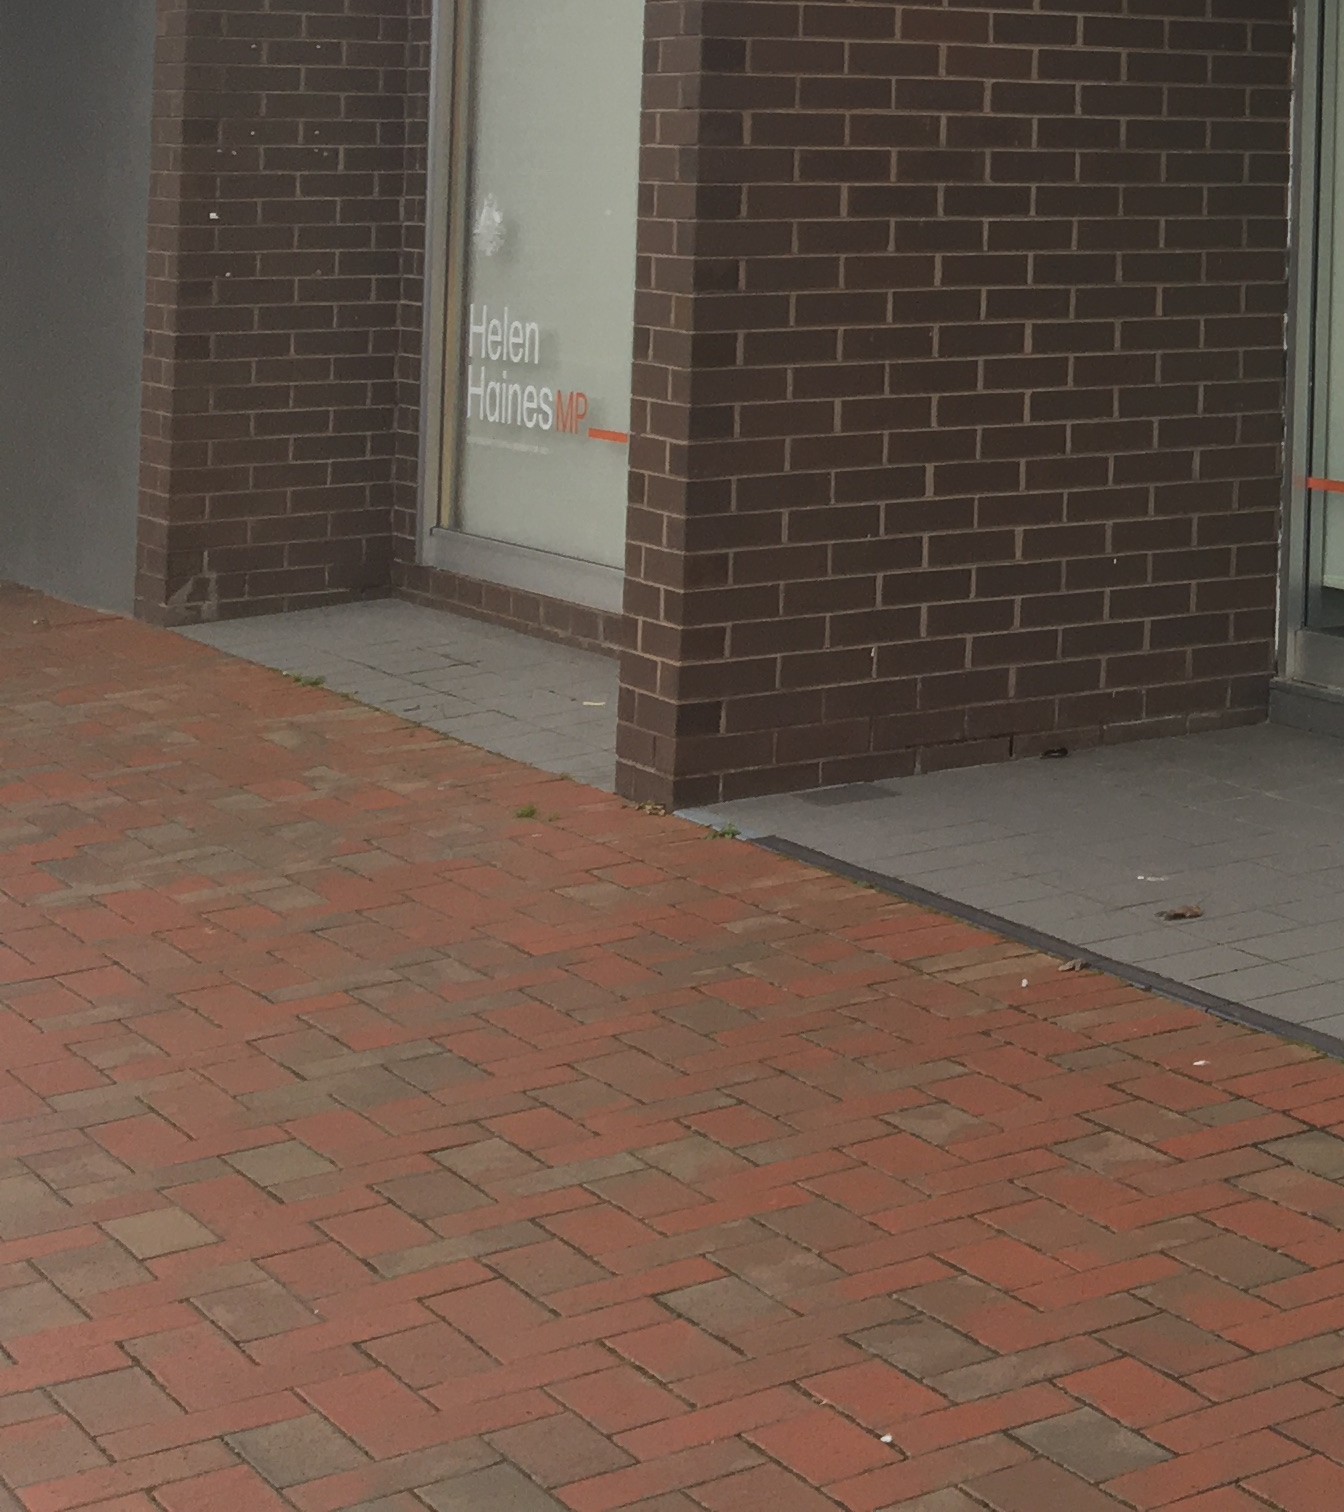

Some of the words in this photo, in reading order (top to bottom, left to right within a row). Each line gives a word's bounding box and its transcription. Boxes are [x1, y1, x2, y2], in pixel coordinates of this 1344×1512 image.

[468, 303, 539, 365] Helen
[466, 364, 553, 431] Haines
[554, 390, 588, 435] MP
